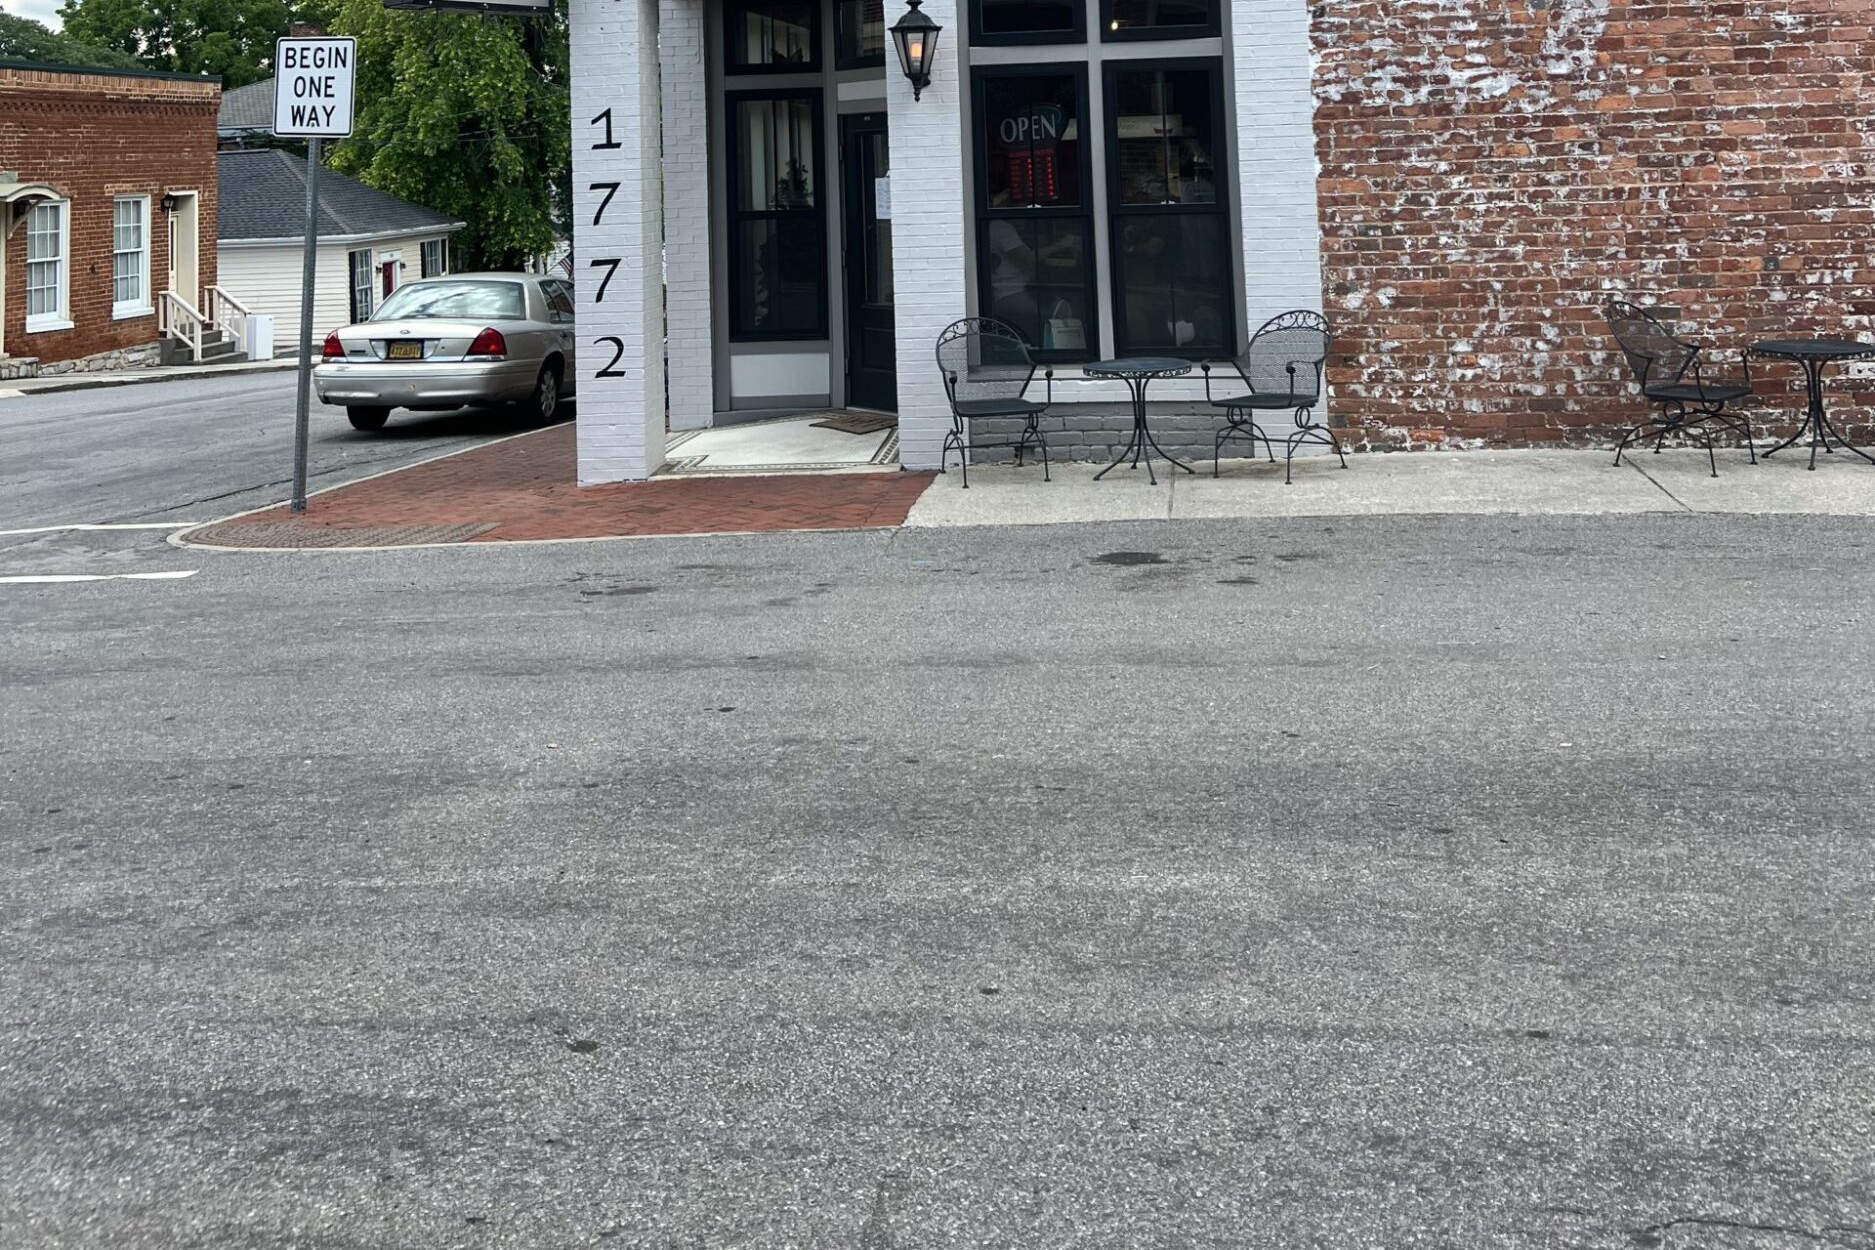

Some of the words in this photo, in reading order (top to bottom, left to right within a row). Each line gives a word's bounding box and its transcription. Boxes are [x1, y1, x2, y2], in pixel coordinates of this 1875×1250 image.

[285, 46, 348, 68] BEGIN
[294, 76, 336, 98] ONE
[291, 105, 336, 127] WAY
[1000, 114, 1056, 143] OPEN
[588, 107, 627, 379] 1772
